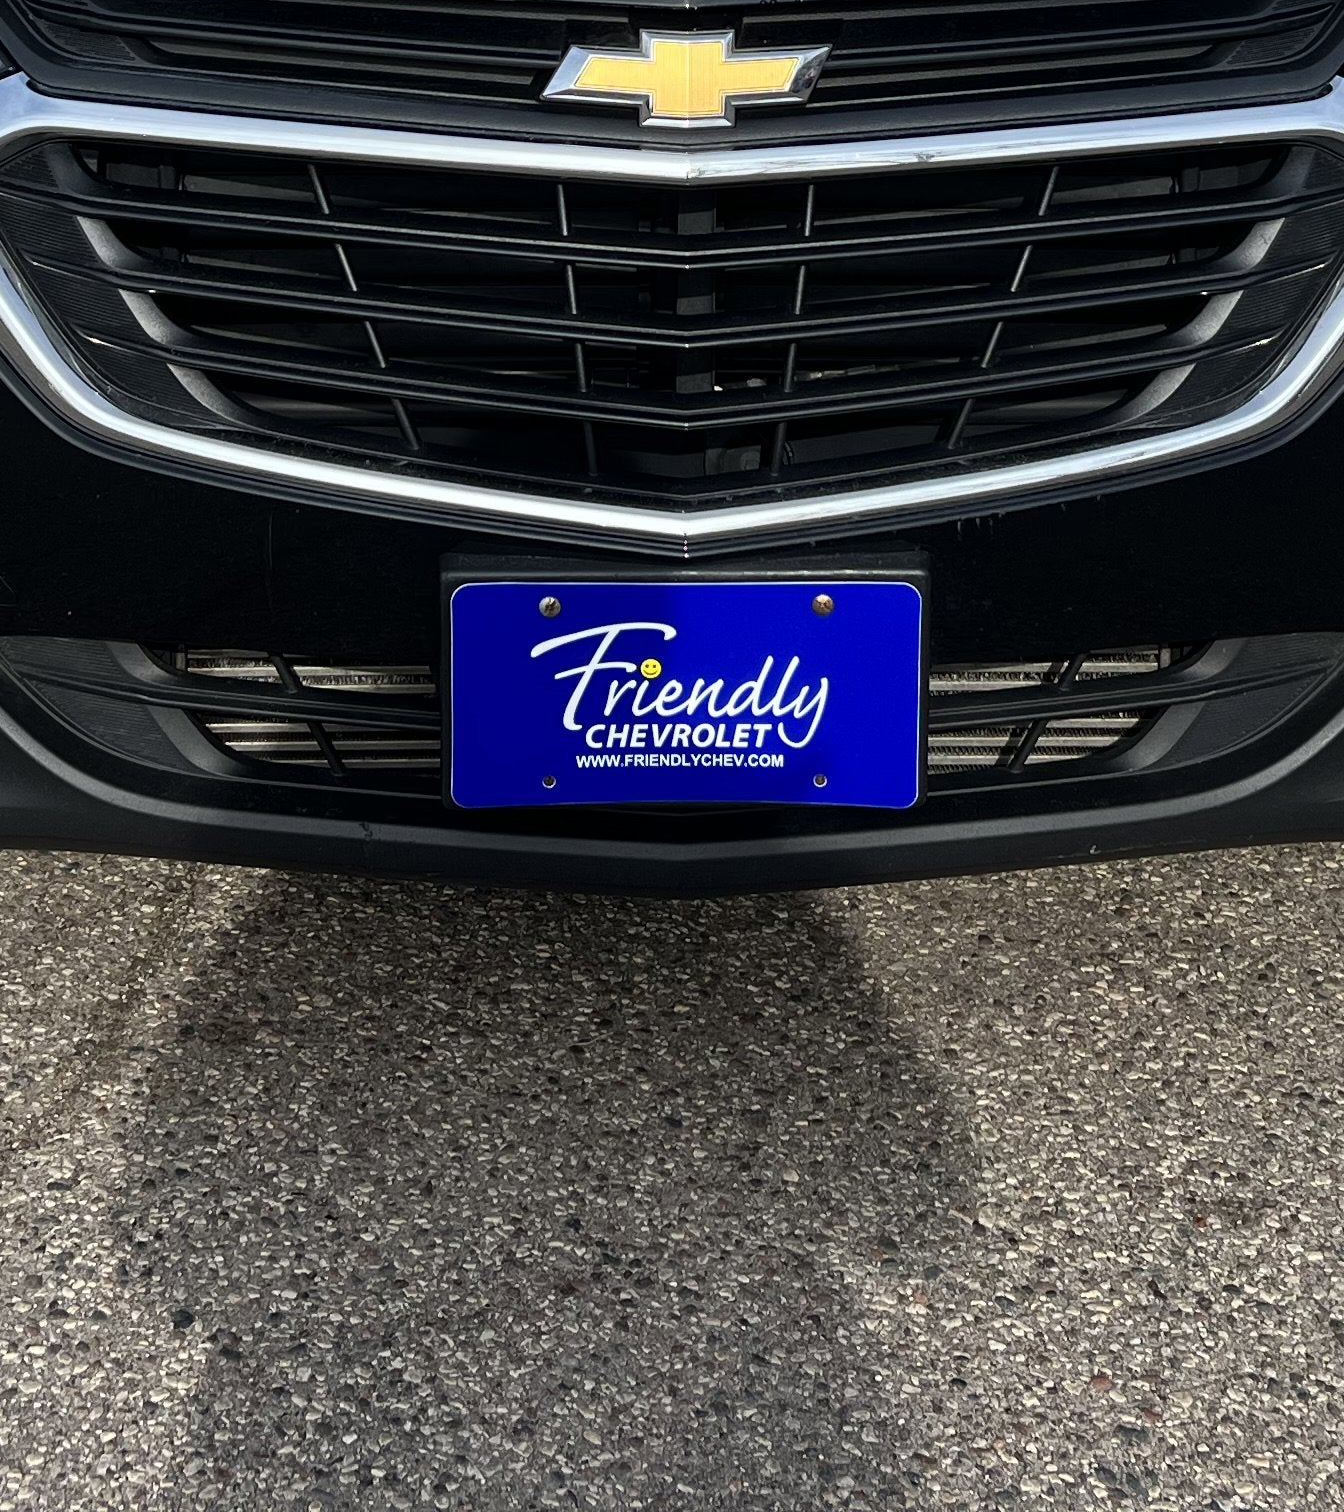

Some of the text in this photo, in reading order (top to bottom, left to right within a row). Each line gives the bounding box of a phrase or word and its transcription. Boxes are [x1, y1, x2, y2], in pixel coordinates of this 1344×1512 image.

[530, 621, 829, 748] Friendly
[585, 723, 773, 749] CHEVROLET
[576, 753, 784, 768] WWW.FRIENDLYCHEV.COM
